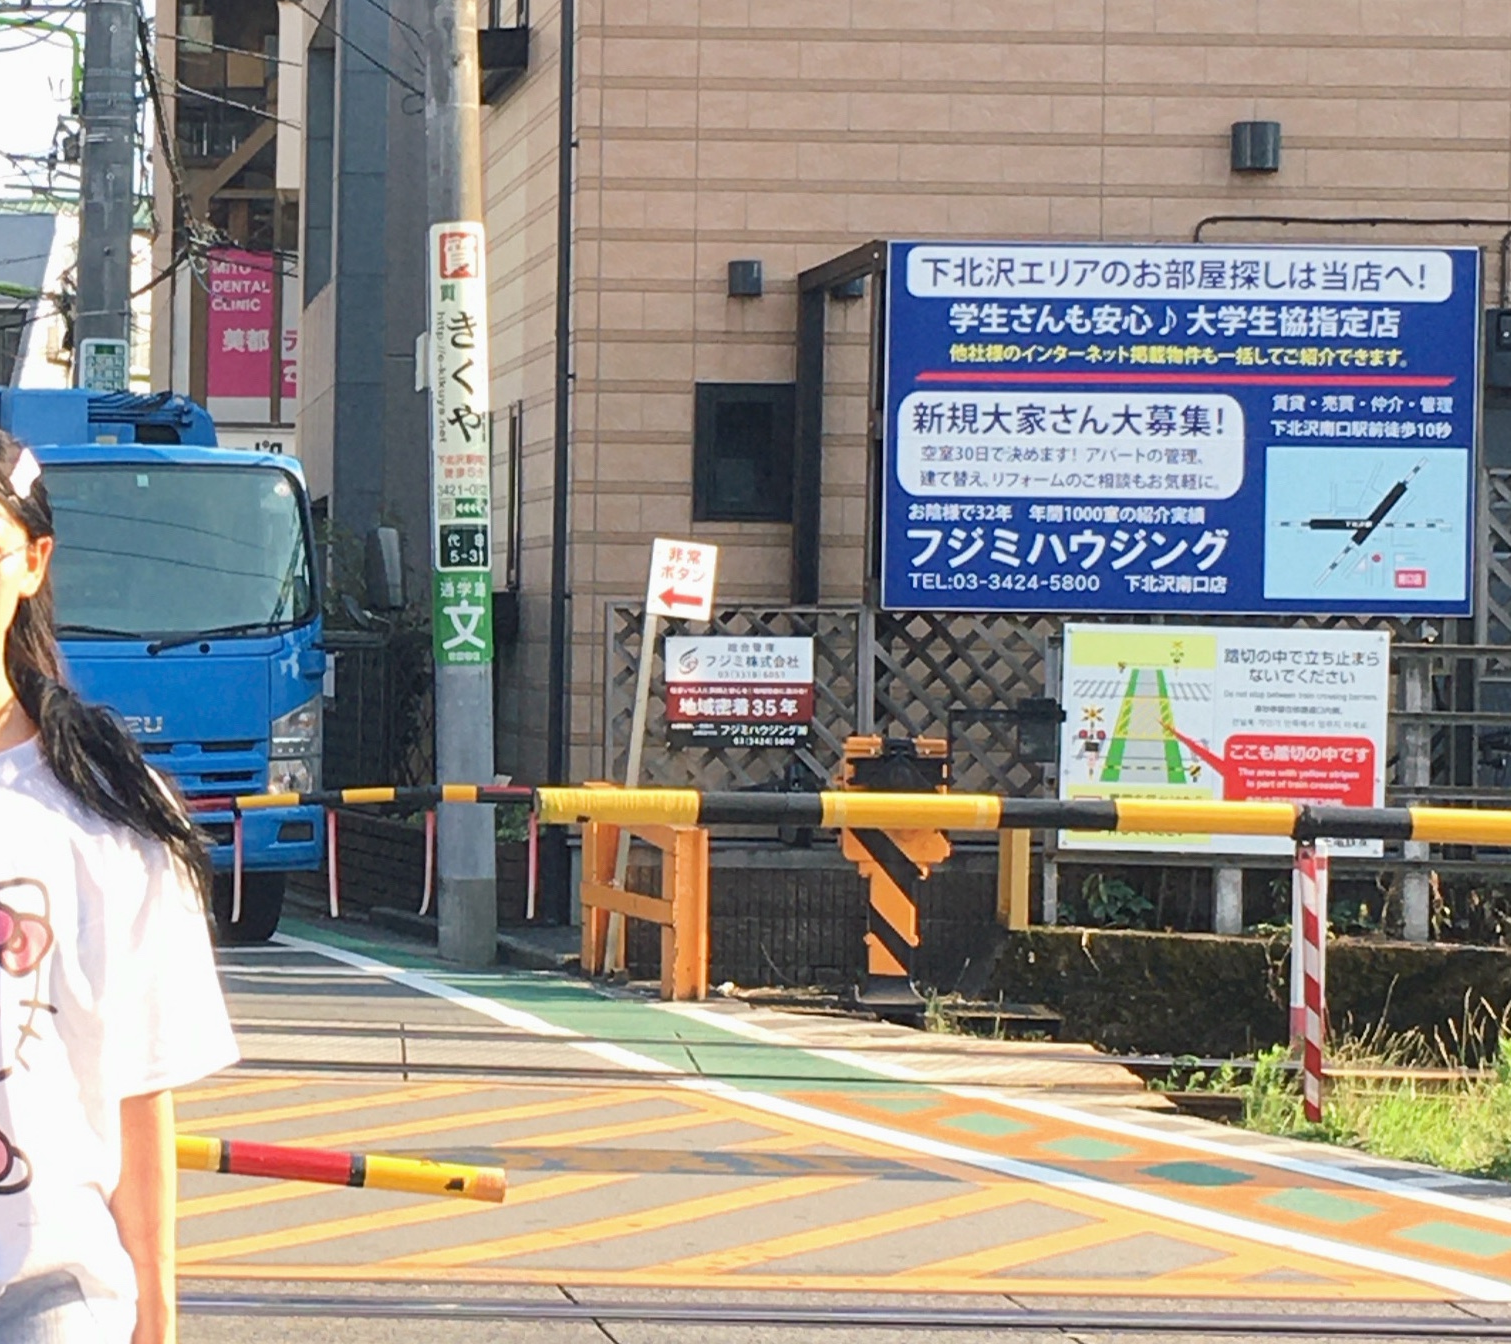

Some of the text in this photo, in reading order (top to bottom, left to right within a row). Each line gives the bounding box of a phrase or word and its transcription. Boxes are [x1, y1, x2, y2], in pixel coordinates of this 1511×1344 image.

[212, 280, 271, 294] DENTAL
[211, 298, 261, 312] CLINIC
[447, 311, 482, 443] きくや
[913, 402, 1225, 437] 新規大家さん大募集!
[668, 545, 702, 565] 非常
[907, 528, 1230, 571] フジミハウジング
[660, 565, 706, 583] ボタン
[908, 573, 1100, 592] TEL:03-3424-5800
[442, 599, 486, 650] 文
[706, 655, 799, 669] フジミ株式会社
[1224, 648, 1381, 667] 踏切の中で立ち止まら
[1248, 668, 1356, 685] ないでください
